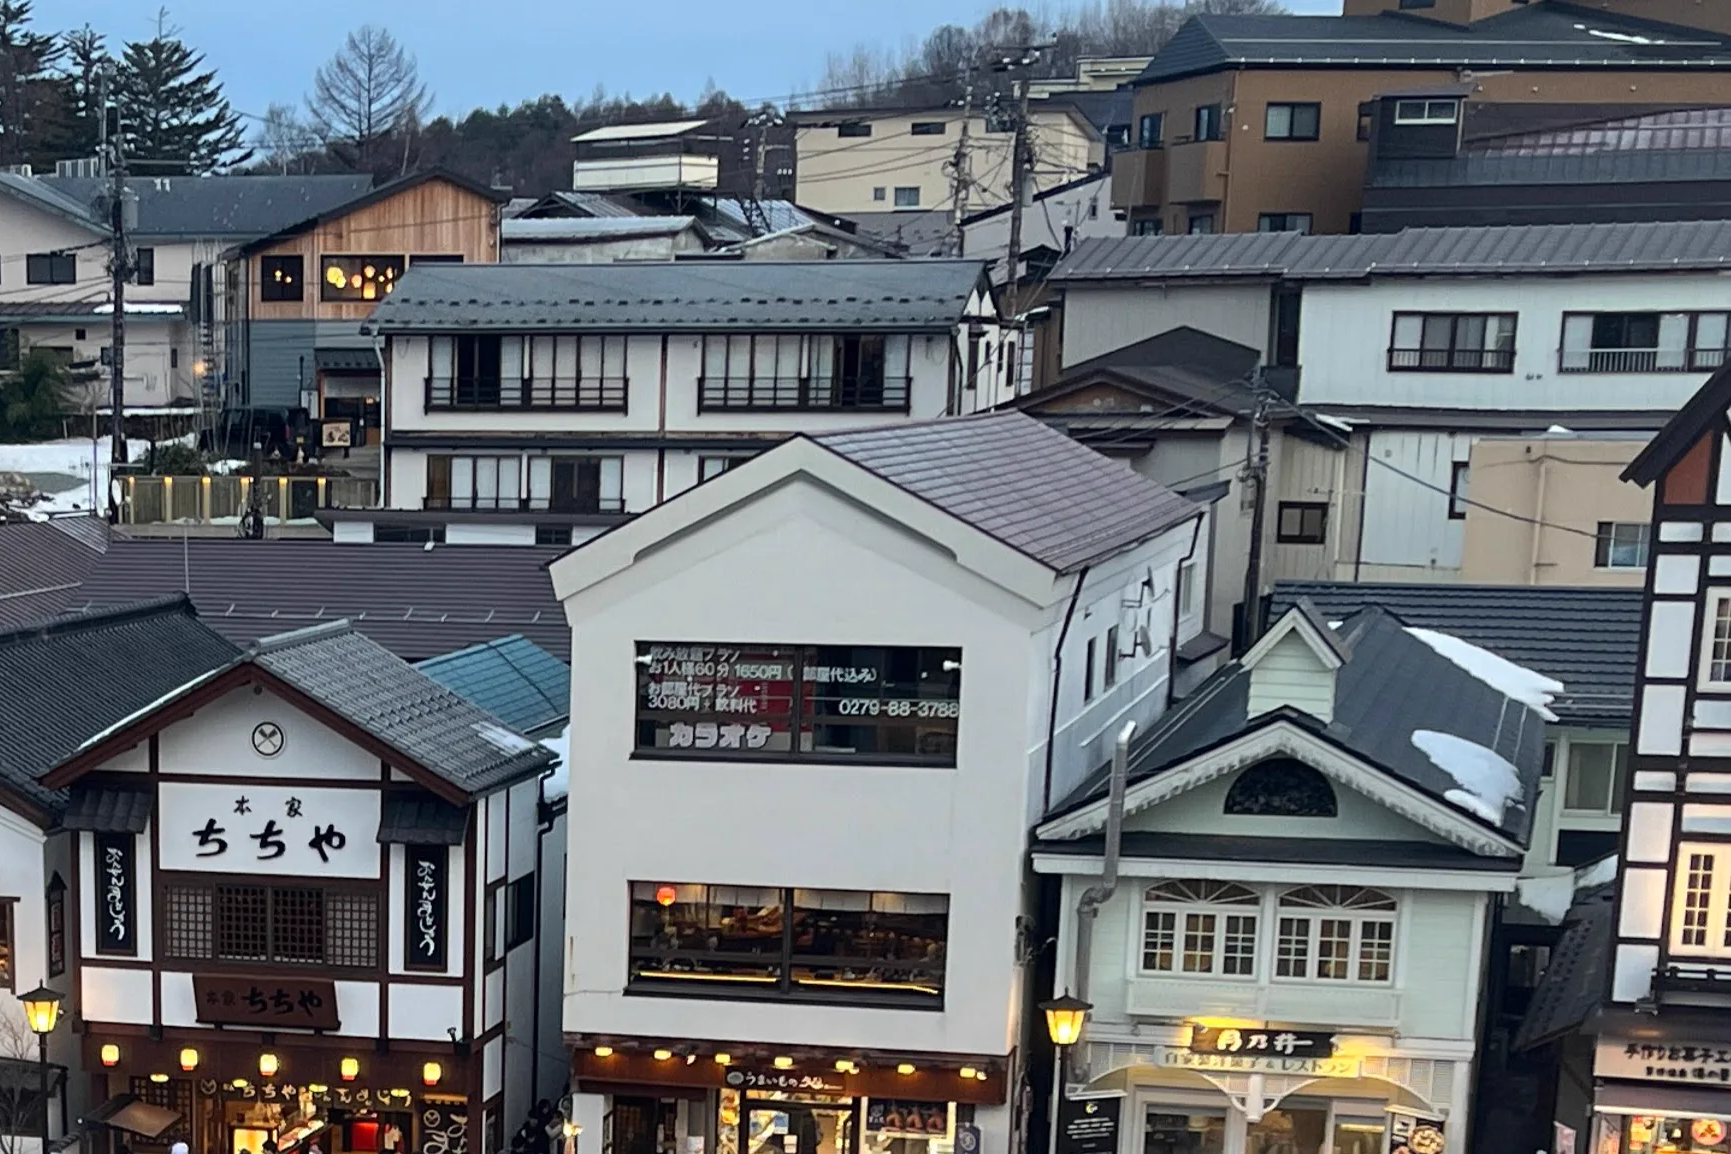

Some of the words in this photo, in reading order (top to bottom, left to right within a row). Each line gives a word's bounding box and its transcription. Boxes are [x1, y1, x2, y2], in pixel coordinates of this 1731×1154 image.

[734, 664, 782, 679] 1650円
[838, 700, 959, 717] 0279-88-3788
[669, 722, 772, 748] カラオケ
[233, 795, 304, 818] 本家
[191, 818, 347, 863] ちちや
[240, 986, 323, 1018] ちちや
[1216, 1028, 1314, 1055] 月乃井
